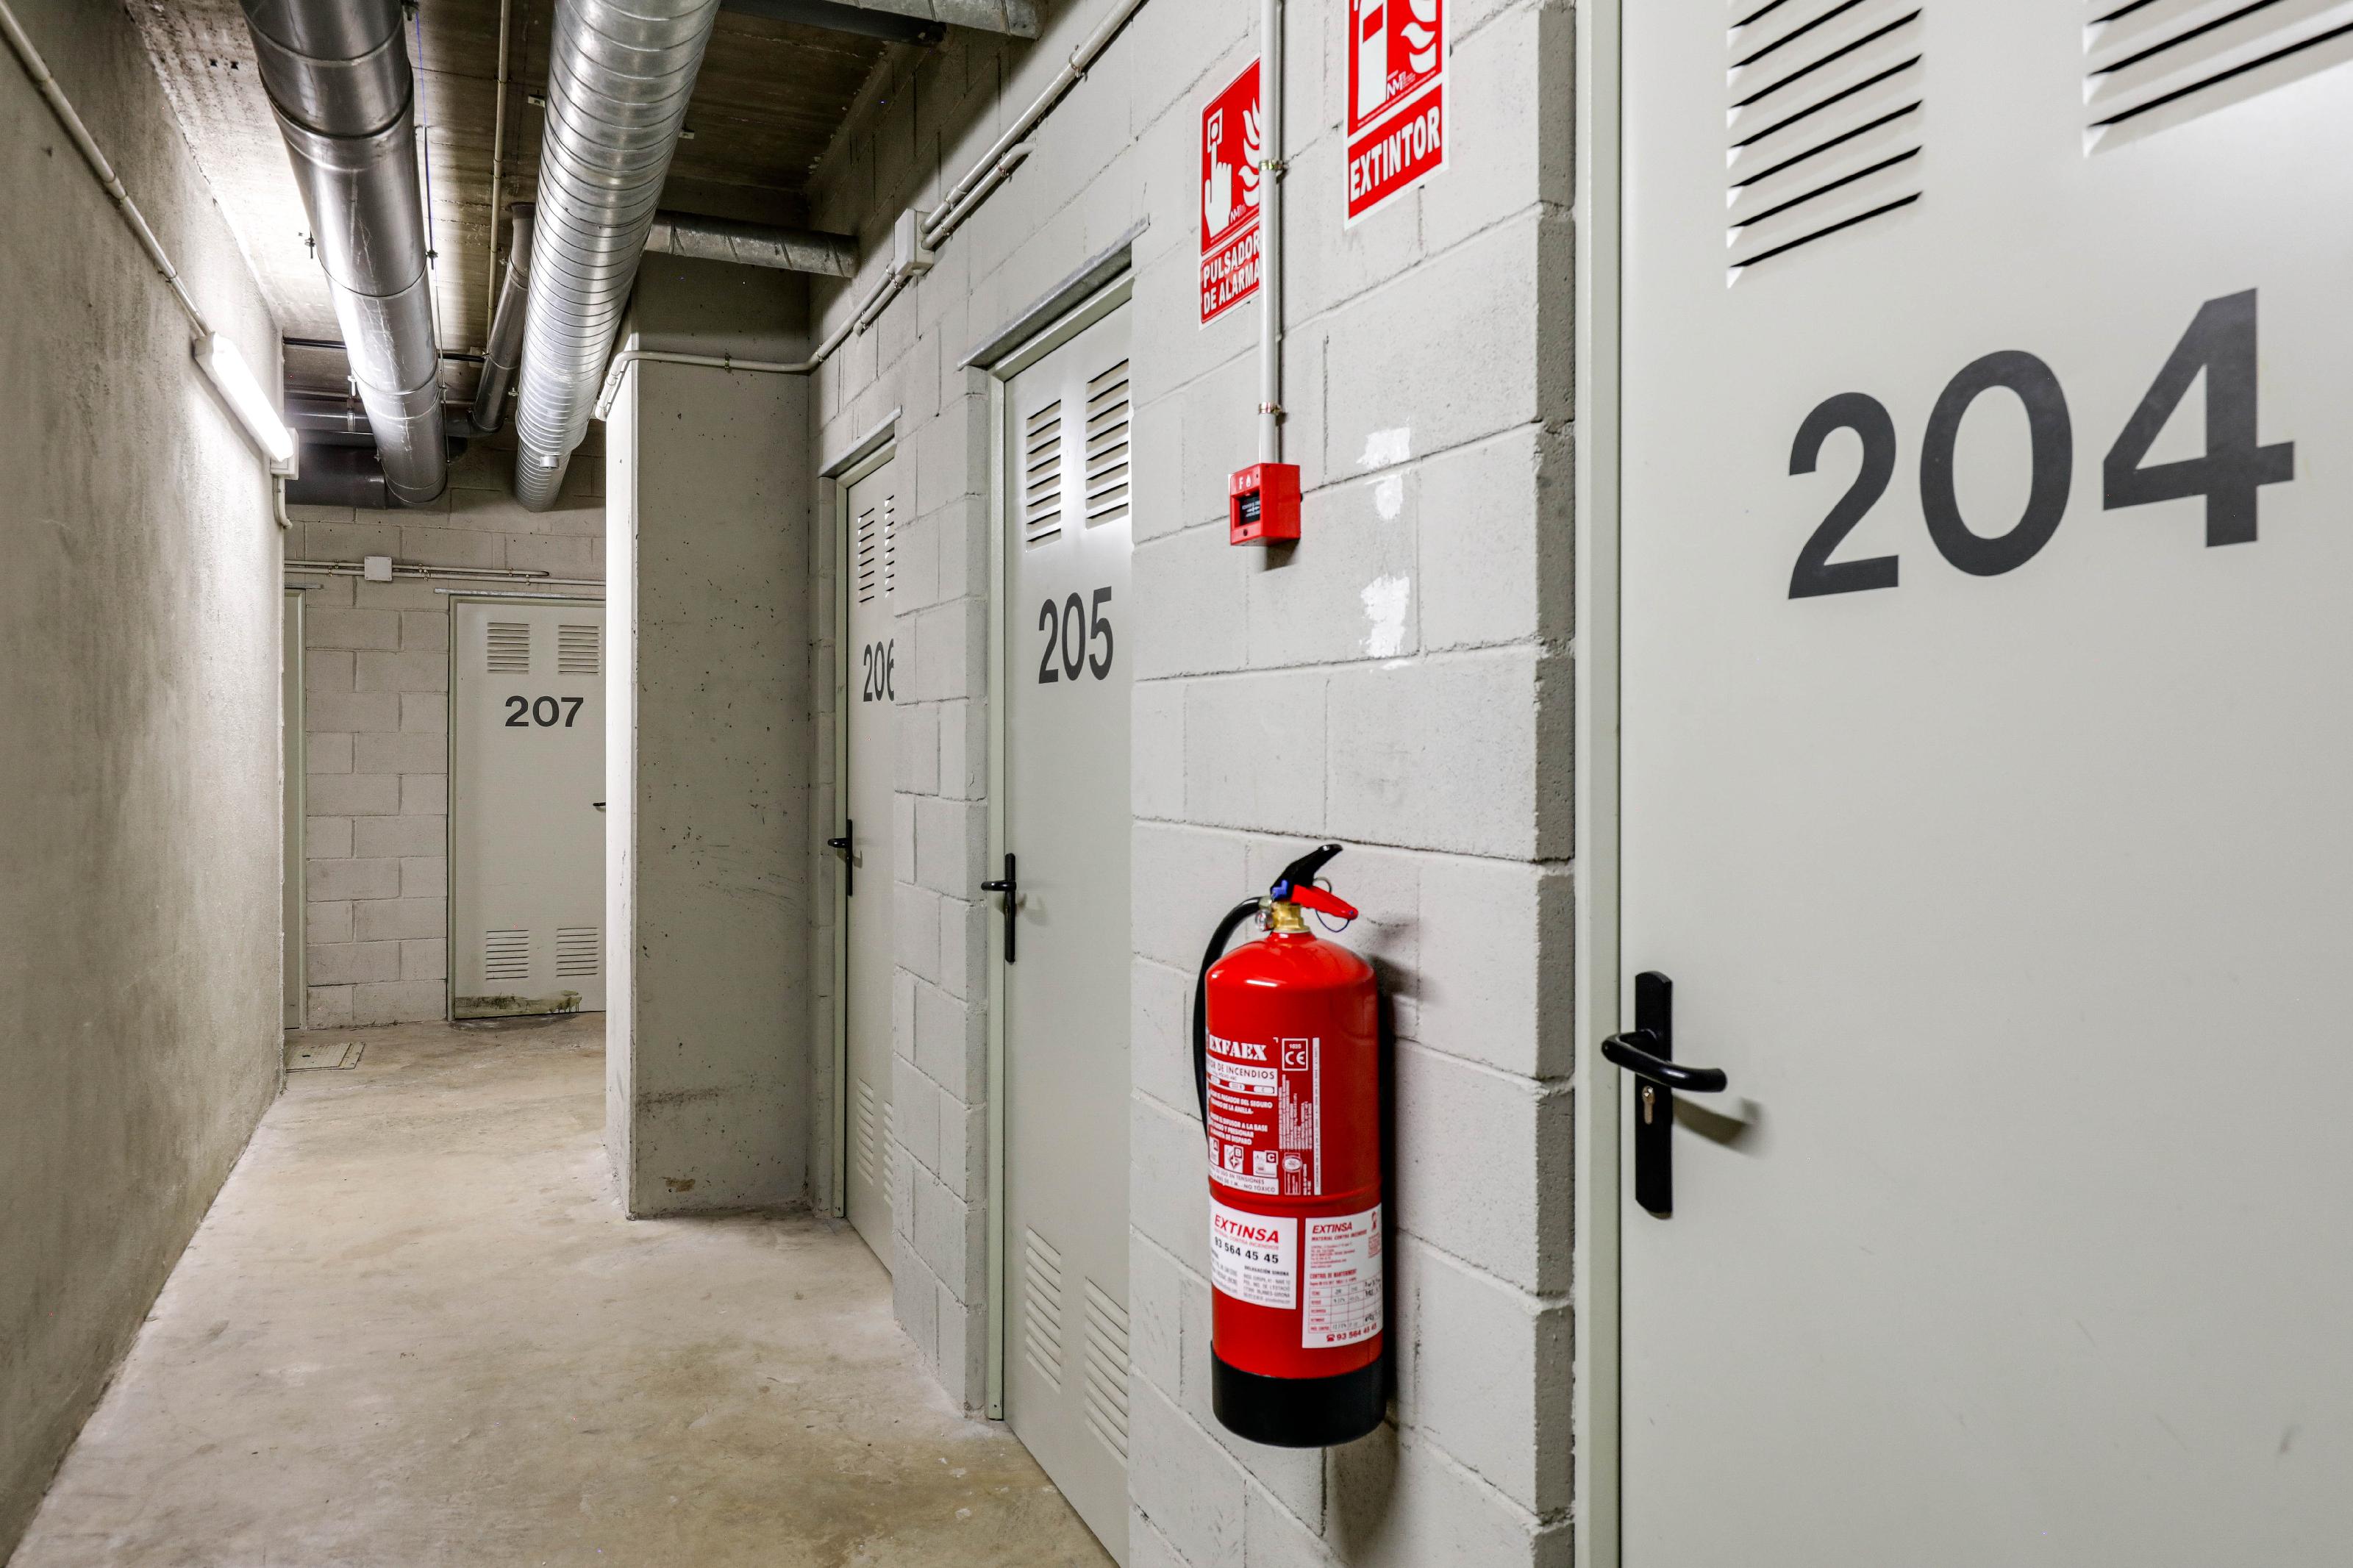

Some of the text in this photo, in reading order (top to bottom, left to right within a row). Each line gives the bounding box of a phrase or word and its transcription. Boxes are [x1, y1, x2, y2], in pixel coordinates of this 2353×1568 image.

[1350, 106, 1440, 202] EXTINTOR
[1204, 229, 1260, 288] PULSADOR
[1204, 258, 1260, 315] DE ALARMA
[1788, 287, 2295, 599] 204
[1038, 586, 1113, 684] 205
[505, 695, 584, 727] 207
[1285, 1051, 1305, 1065] CE
[1226, 1065, 1275, 1079] INCENDIOS
[1267, 1153, 1275, 1162] C
[1236, 1175, 1265, 1185] TENSIONES
[1214, 1214, 1279, 1243] EXTINSA
[1312, 1221, 1353, 1234] EXTINSA
[1224, 1242, 1241, 1256] 564
[1245, 1250, 1258, 1261] 45
[1264, 1253, 1279, 1264] 45
[1349, 1330, 1361, 1338] 564
